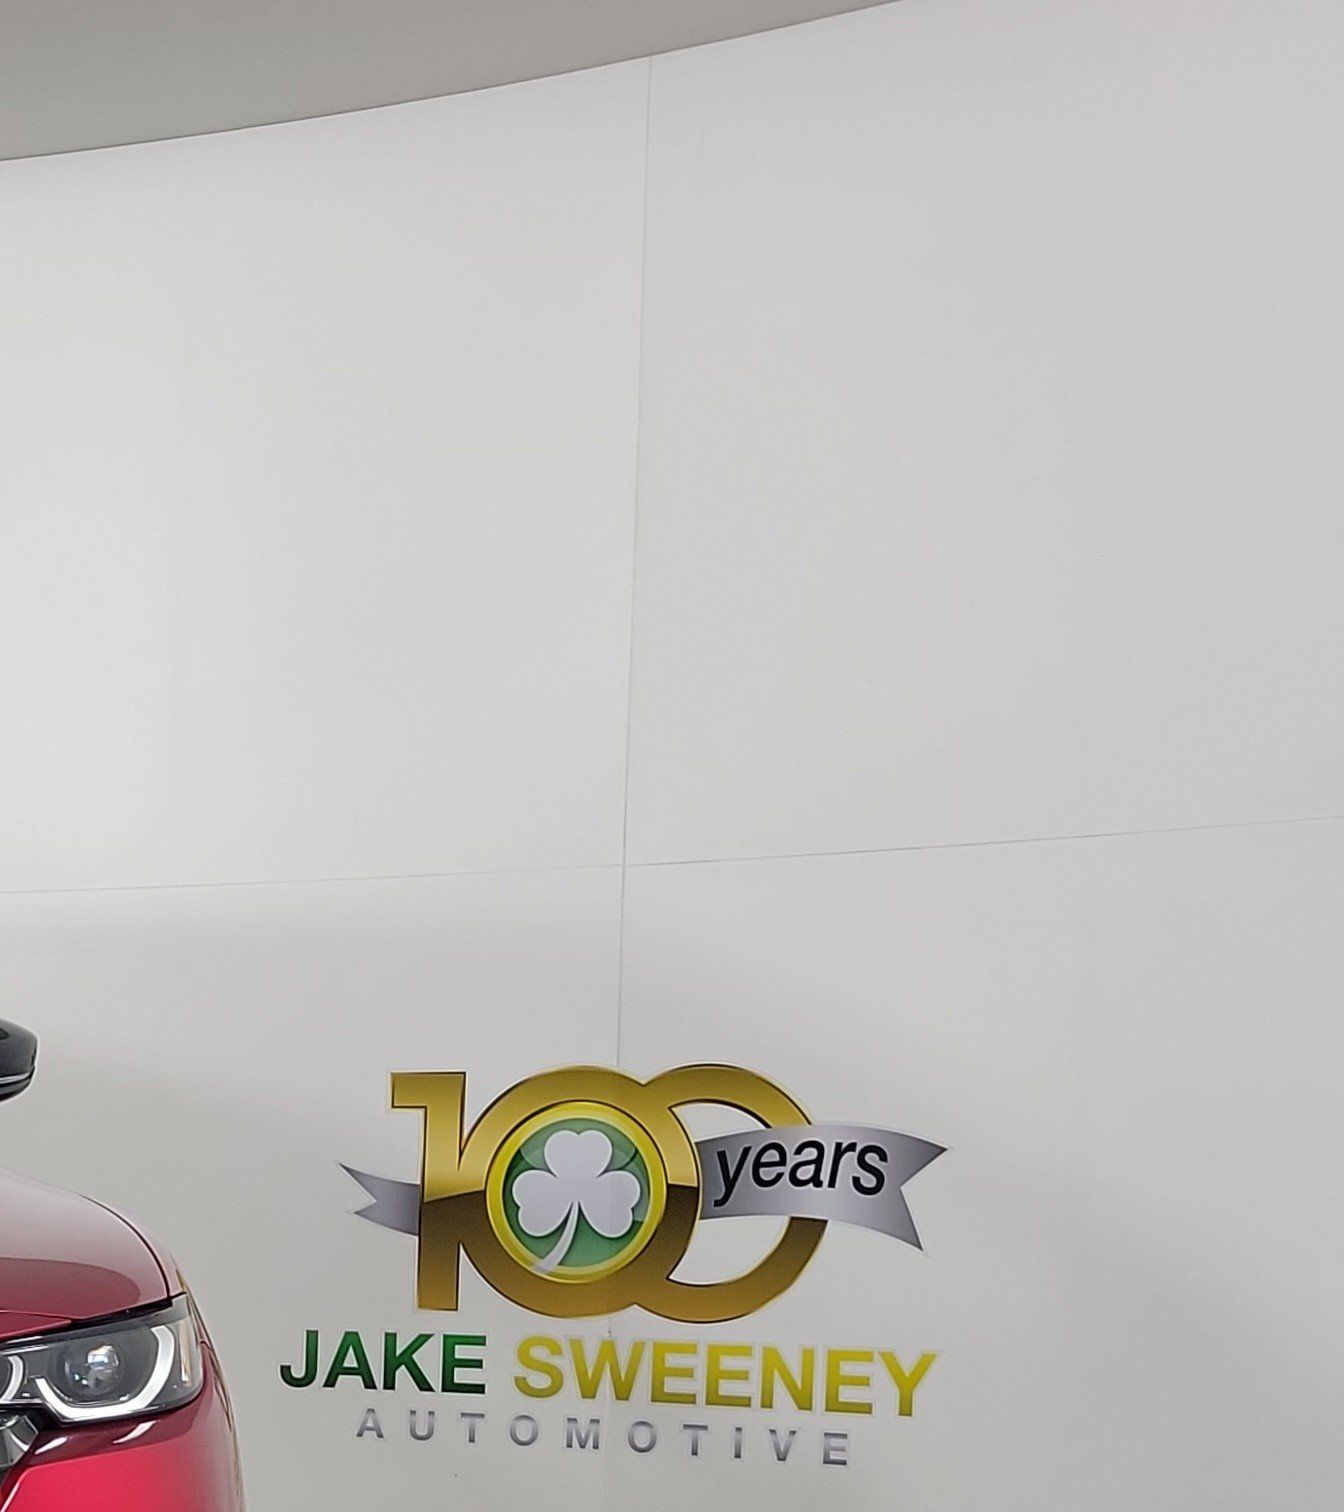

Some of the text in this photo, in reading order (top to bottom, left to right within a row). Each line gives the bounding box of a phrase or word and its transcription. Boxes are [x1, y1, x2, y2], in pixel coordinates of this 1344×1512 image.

[714, 1137, 890, 1207] years
[278, 1329, 939, 1418] JAKE SWEENEY
[355, 1407, 849, 1466] AUTOMOTIVE
